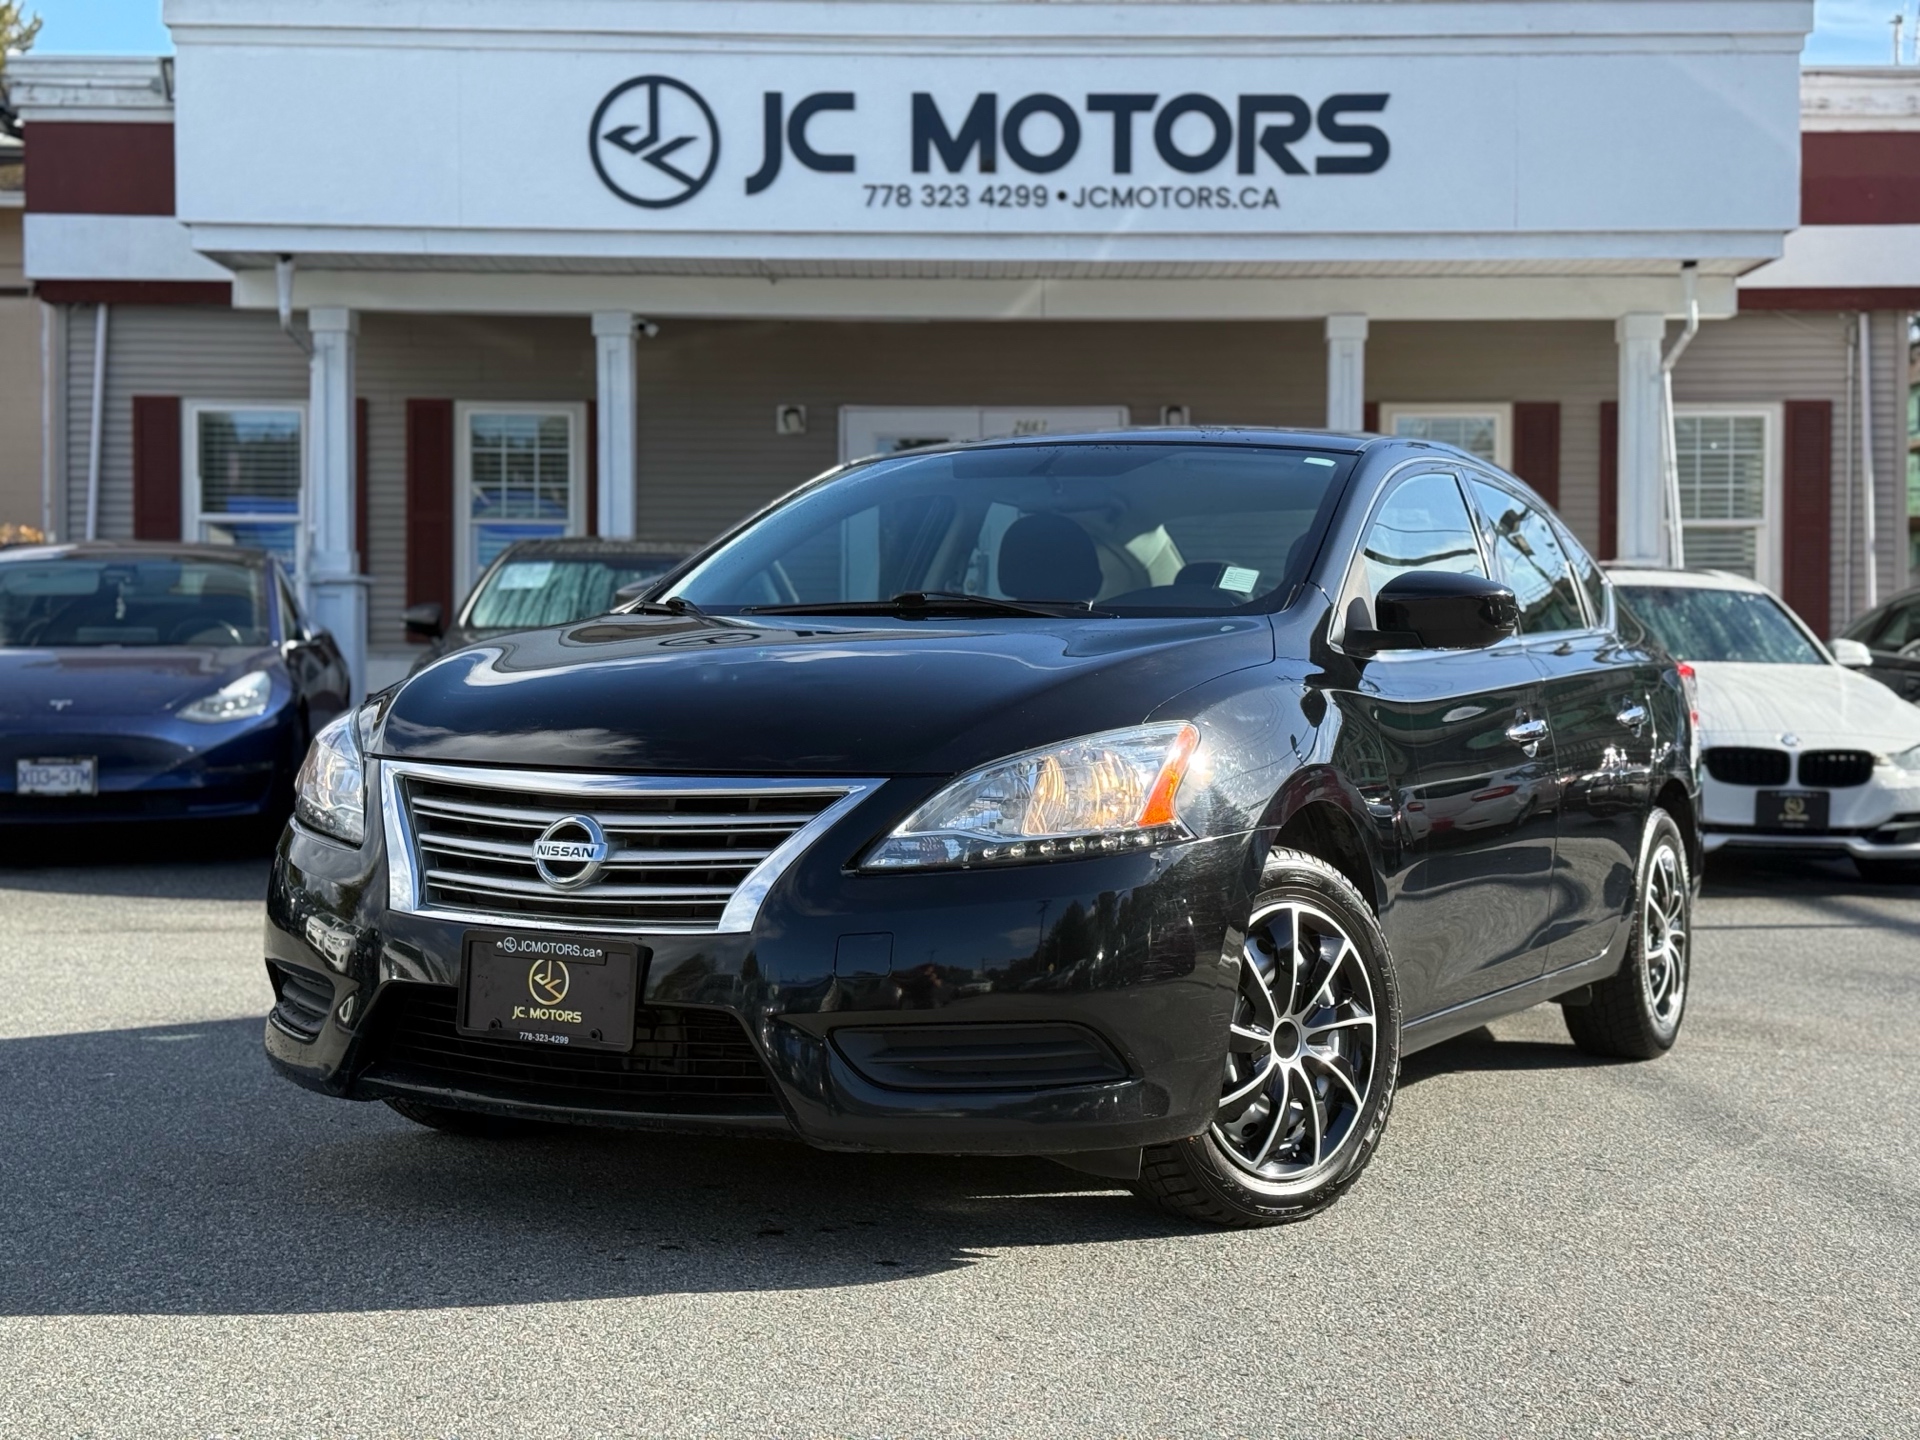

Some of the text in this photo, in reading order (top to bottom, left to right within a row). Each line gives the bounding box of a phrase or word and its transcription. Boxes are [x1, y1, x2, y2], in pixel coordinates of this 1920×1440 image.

[745, 91, 1391, 195] JC MOTORS
[863, 184, 1280, 209] 778 323 4299 JCMOTORS.CA
[537, 844, 595, 858] NISSAN
[517, 940, 596, 958] JCMOTORS.ca
[529, 1007, 582, 1024] MOTORS
[519, 1031, 570, 1045] 778-323-4299
